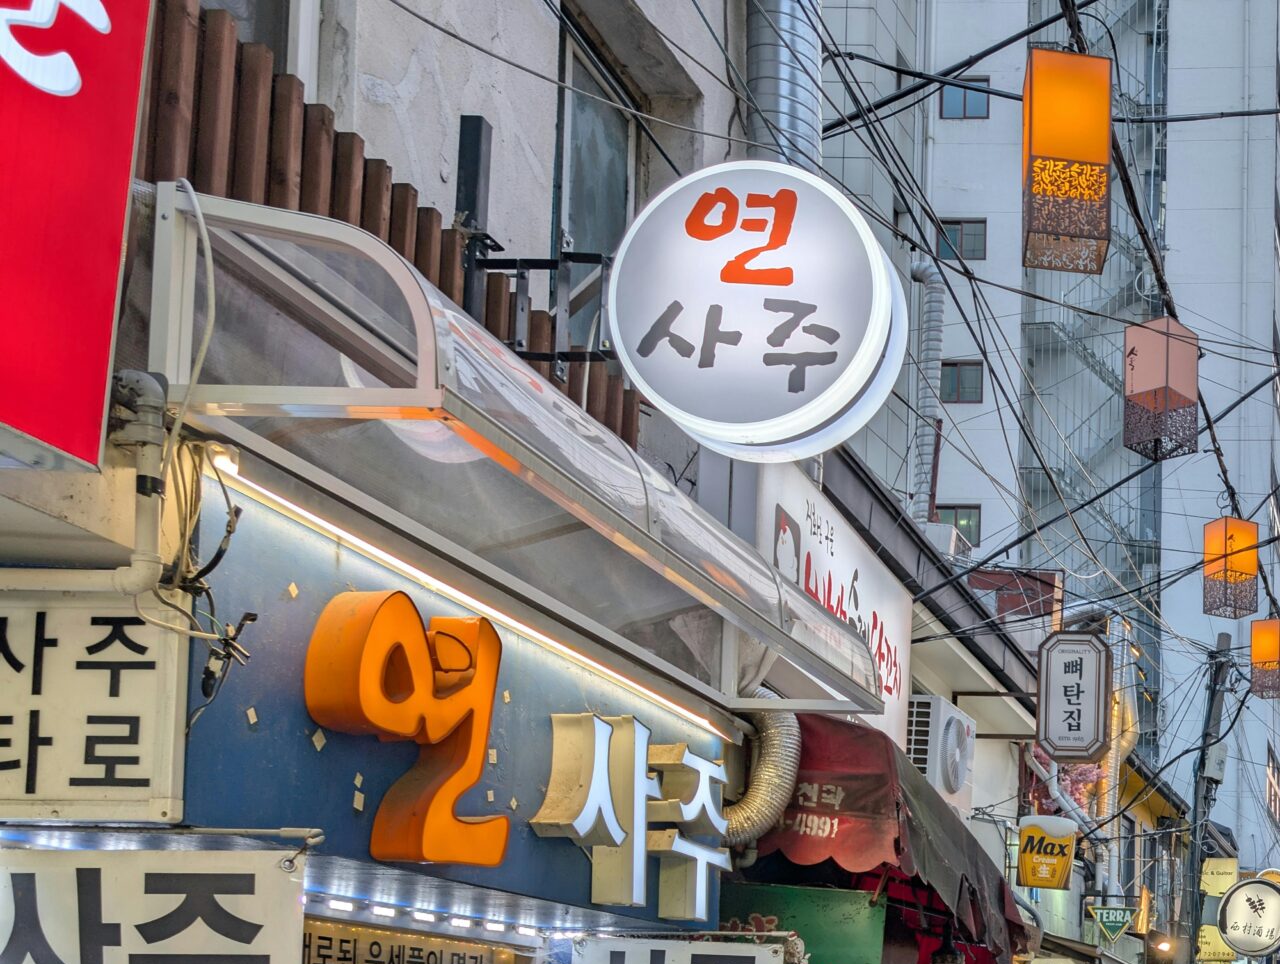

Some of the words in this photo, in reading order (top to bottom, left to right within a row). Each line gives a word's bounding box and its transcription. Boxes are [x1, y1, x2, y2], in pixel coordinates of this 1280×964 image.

[684, 187, 798, 287] 연
[636, 298, 840, 394] 사주
[0, 611, 156, 698] 사주
[1062, 656, 1085, 732] 뼈탄집
[0, 709, 151, 795] 타로
[304, 590, 510, 868] 연
[530, 712, 734, 922] 사주
[1022, 835, 1070, 857] Max
[1095, 909, 1132, 922] TERRA
